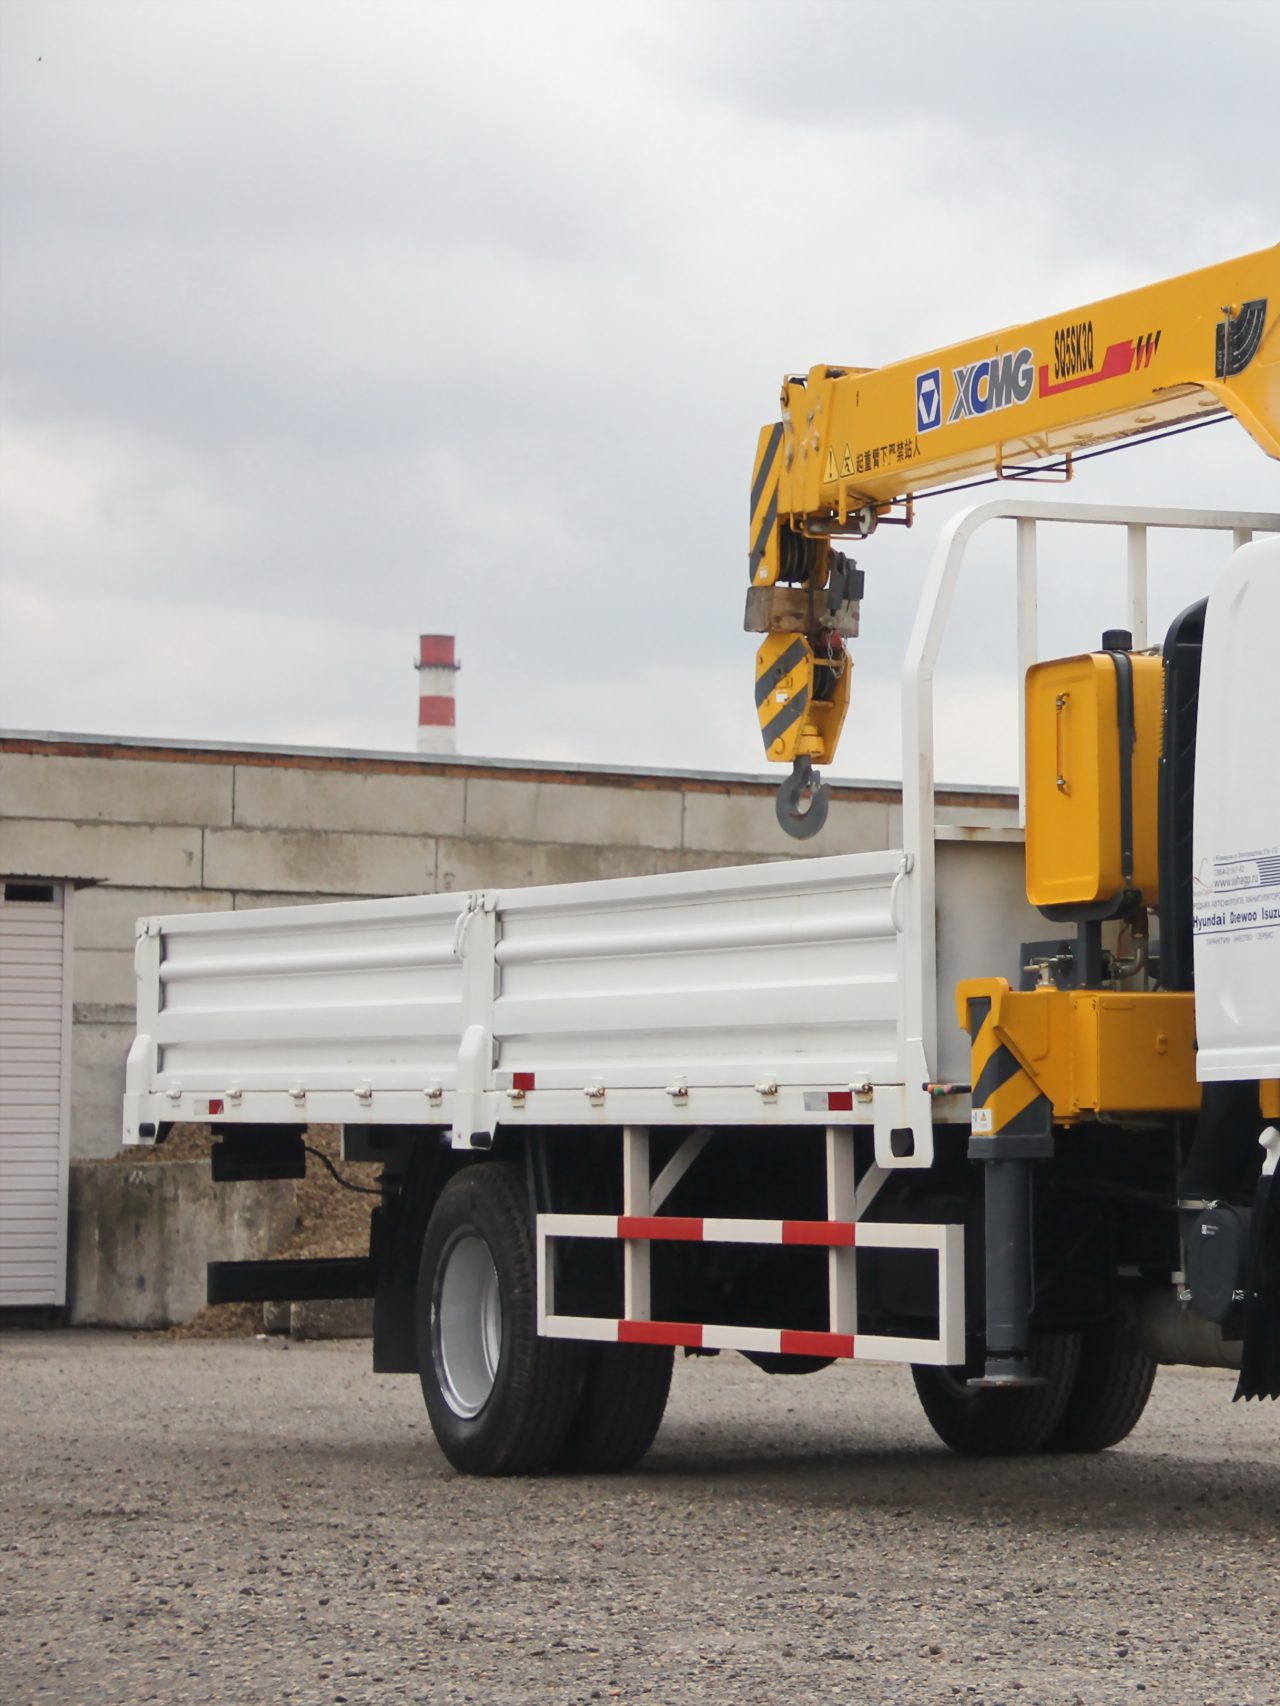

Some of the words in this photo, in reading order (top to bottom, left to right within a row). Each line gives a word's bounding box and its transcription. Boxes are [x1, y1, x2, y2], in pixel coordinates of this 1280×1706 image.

[1054, 320, 1094, 380] SQ5SK3Q
[946, 347, 1035, 425] XCMG
[1192, 912, 1226, 931] Hyundai
